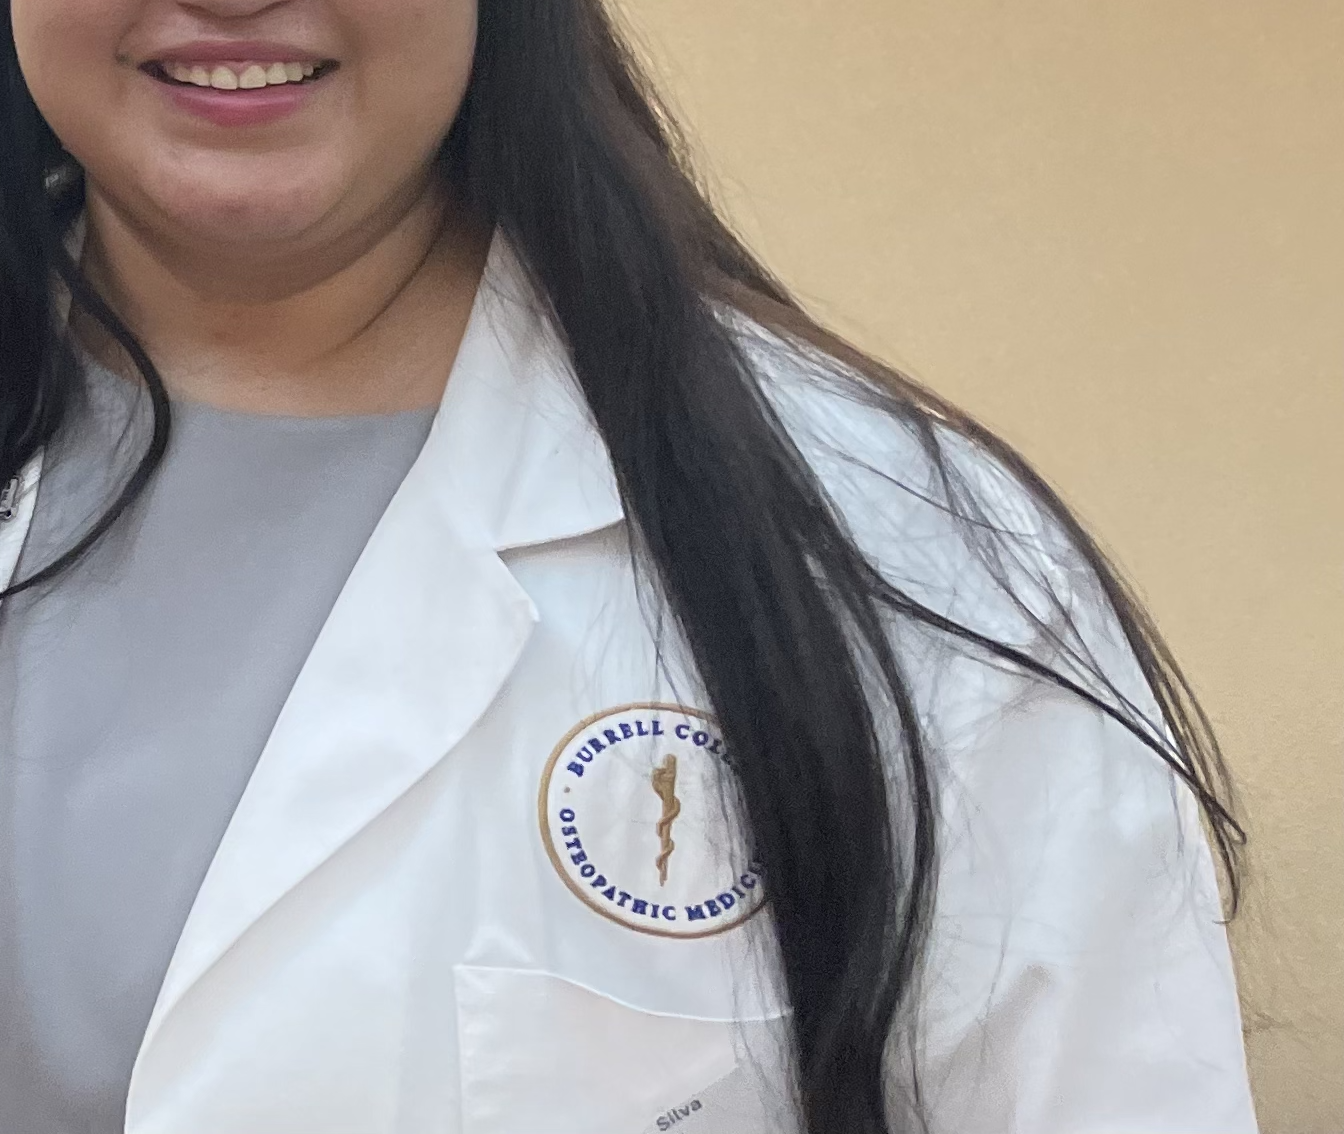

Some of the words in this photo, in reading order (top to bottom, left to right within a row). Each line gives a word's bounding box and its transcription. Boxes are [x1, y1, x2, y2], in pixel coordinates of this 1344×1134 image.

[567, 720, 665, 778] BURRELL
[559, 808, 677, 921] OSTEOPATHIC
[656, 1099, 702, 1131] Silva
